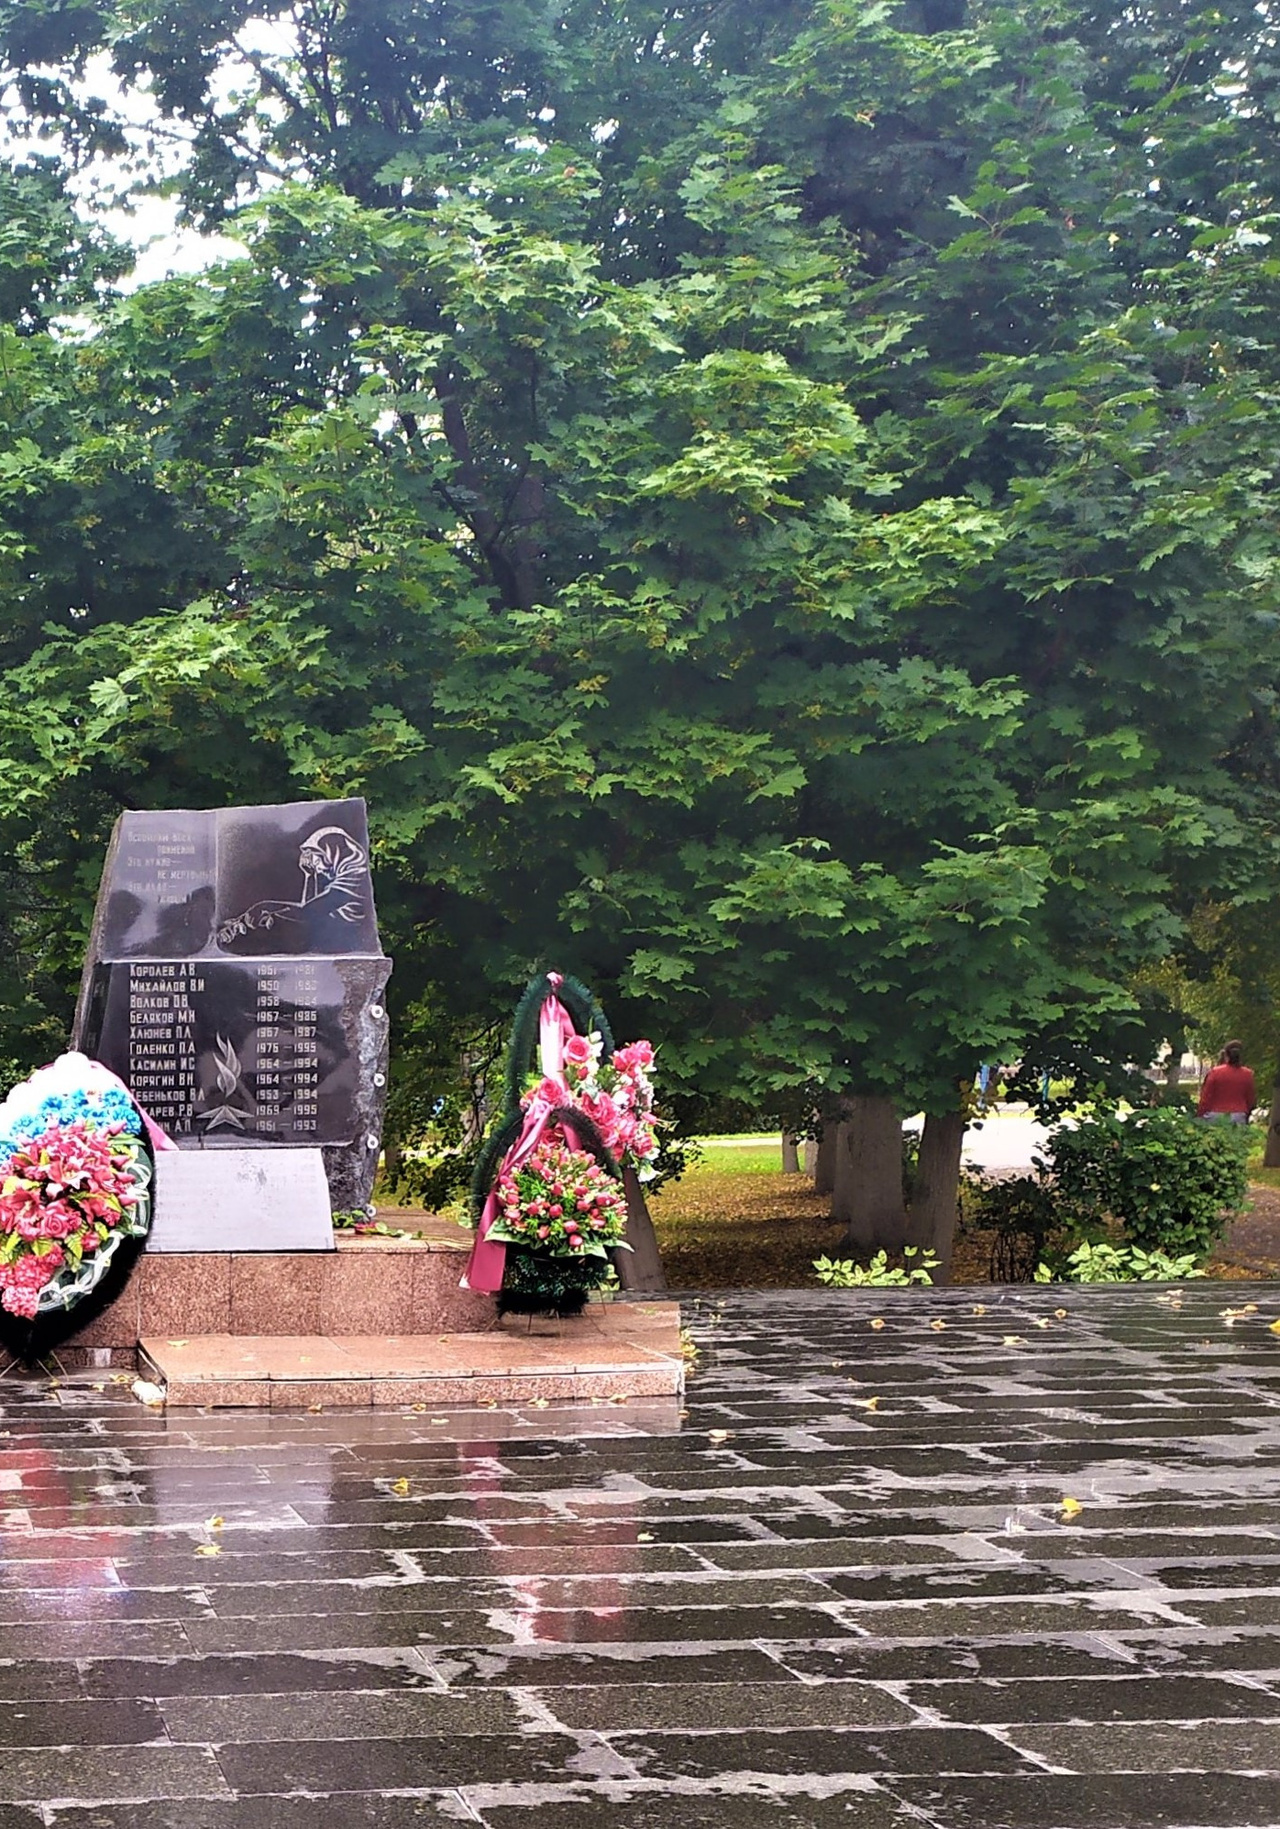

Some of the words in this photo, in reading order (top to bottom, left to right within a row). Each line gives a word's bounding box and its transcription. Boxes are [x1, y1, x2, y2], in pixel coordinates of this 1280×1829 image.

[130, 963, 175, 977] КОРОЛЕВ
[130, 979, 186, 993] МИХАЙЛОВ
[257, 980, 279, 991] 1950
[130, 995, 169, 1008] ВОЛКОВ
[257, 996, 279, 1007] 1958
[130, 1010, 174, 1024] БЕЛЯКОВ
[257, 1011, 279, 1022] 1967
[294, 1011, 317, 1021] 1986
[257, 1027, 279, 1038] 1967
[294, 1026, 316, 1037] 1987
[130, 1041, 175, 1055] ГОЛЕНКО
[256, 1043, 279, 1053] 1976
[294, 1042, 316, 1053] 1995
[130, 1058, 176, 1071] КАСИЛИН
[257, 1058, 280, 1069] 1964
[294, 1058, 318, 1068] 1994
[130, 1073, 175, 1086] КОРЯГИН
[257, 1074, 279, 1085] 1964
[294, 1073, 318, 1084] 1994
[256, 1089, 279, 1100] 1953
[294, 1089, 318, 1100] 1994
[256, 1105, 280, 1116] 1969
[294, 1104, 317, 1115] 1995
[256, 1121, 276, 1131] 1961
[293, 1120, 316, 1131] 1993
